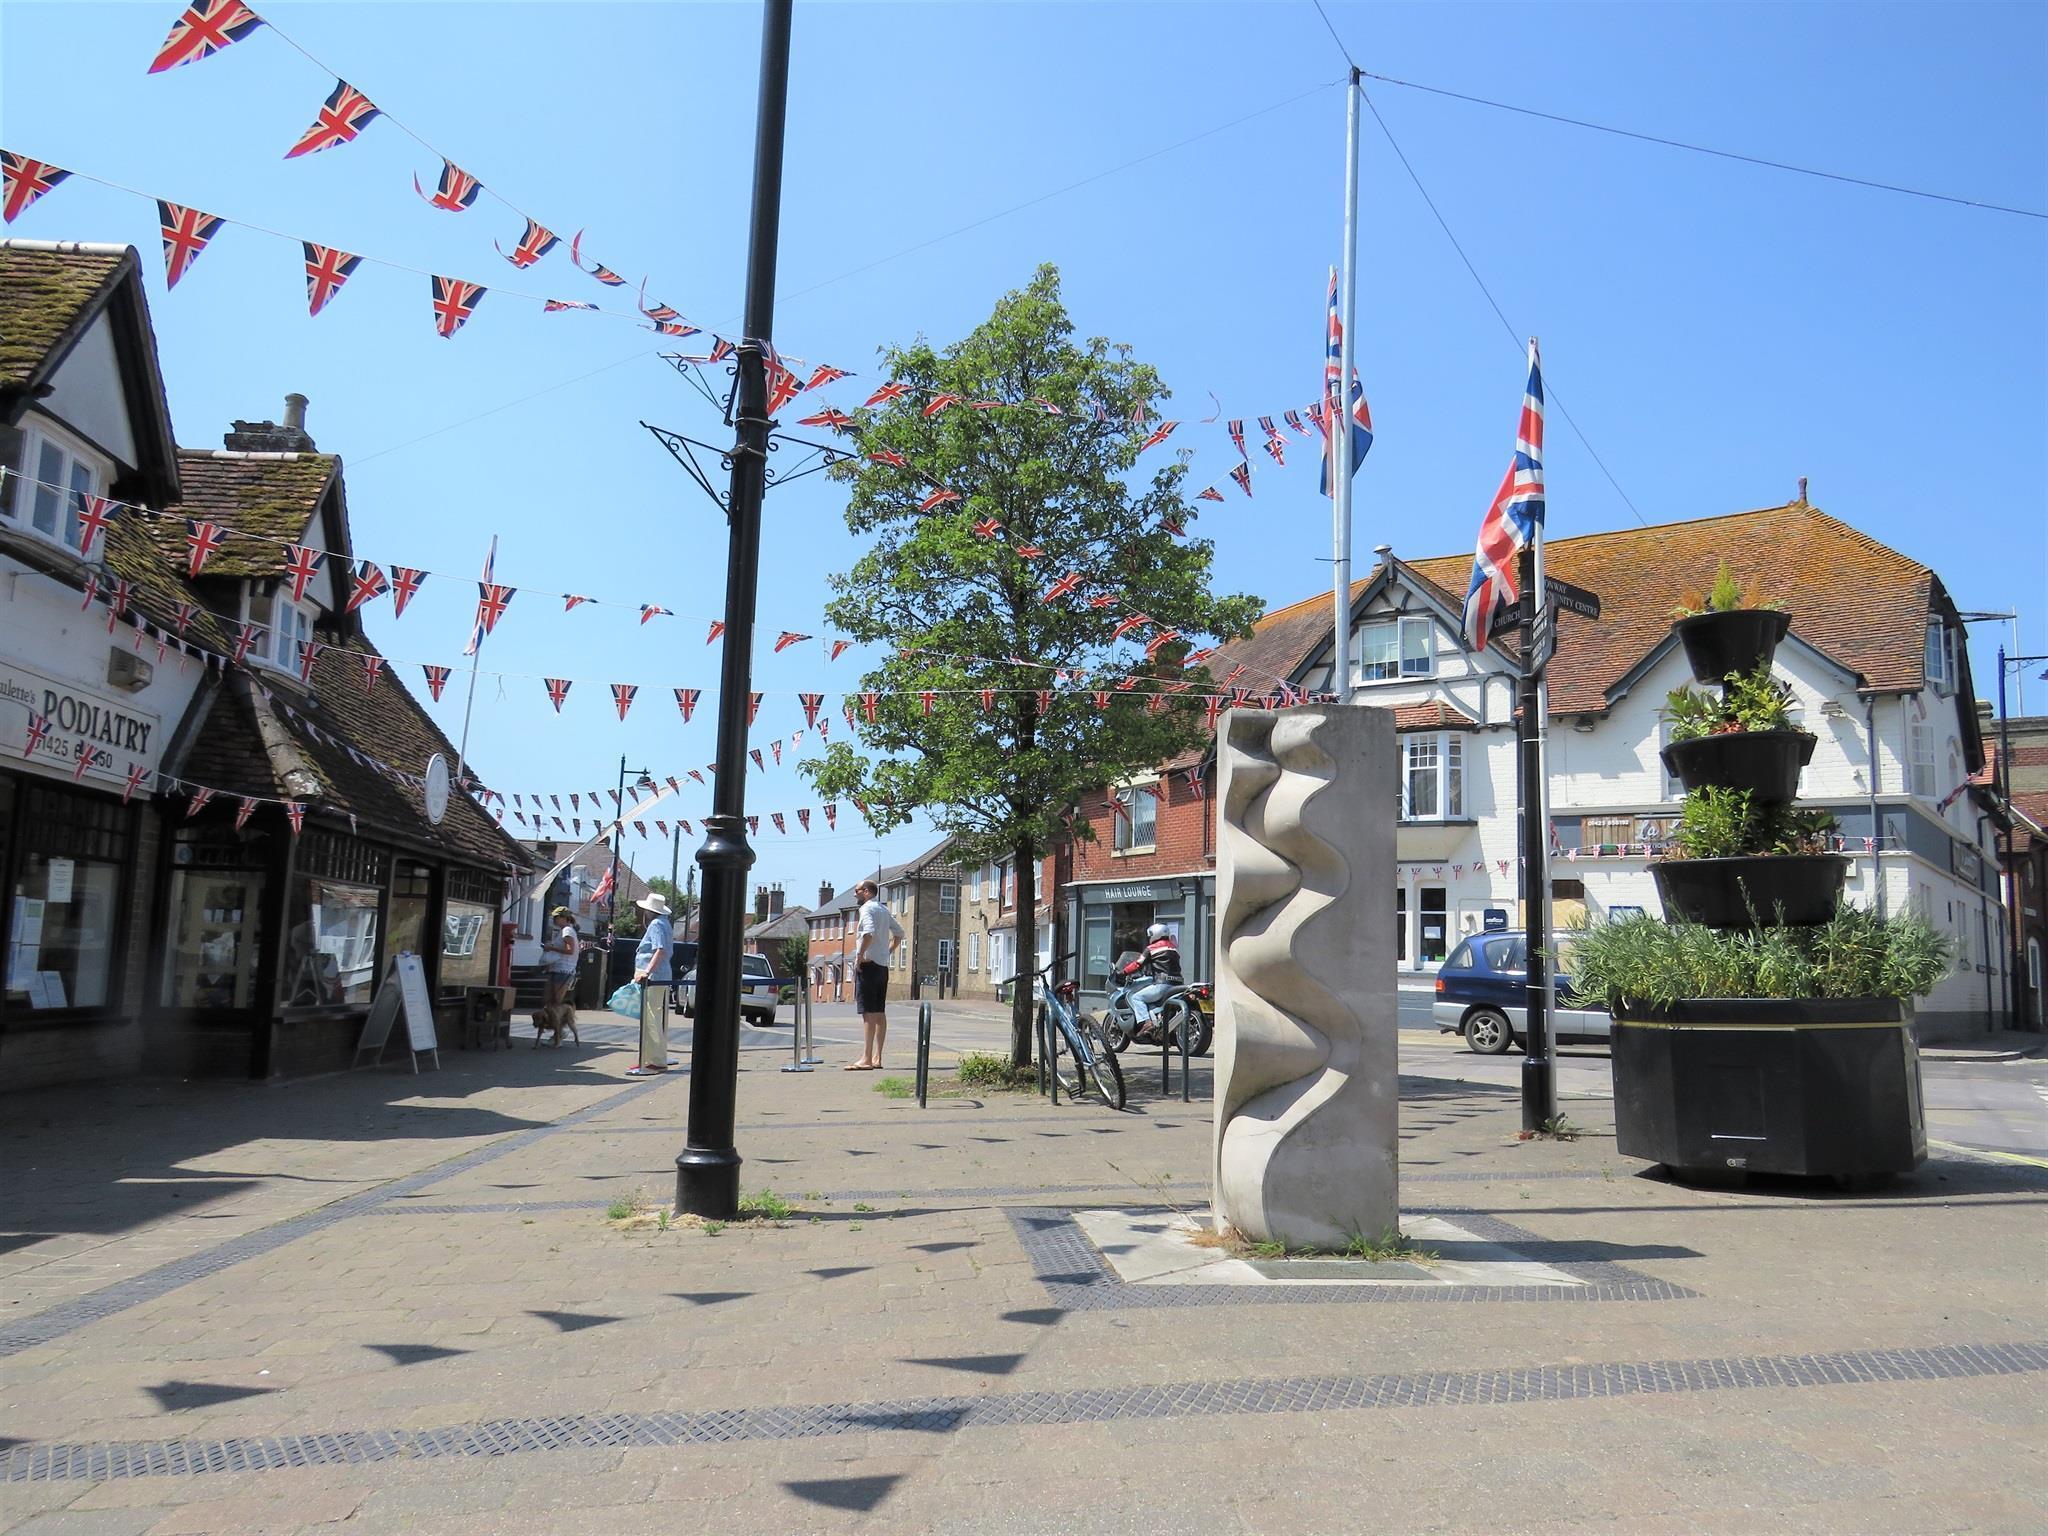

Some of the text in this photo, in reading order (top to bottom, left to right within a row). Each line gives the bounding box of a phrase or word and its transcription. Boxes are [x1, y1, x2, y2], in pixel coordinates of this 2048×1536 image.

[1574, 601, 1598, 617] CENTRE
[1494, 609, 1520, 628] CHURCH
[0, 678, 152, 755] ulette's PODIATRY
[1104, 885, 1152, 899] HAIR LOUNGE
